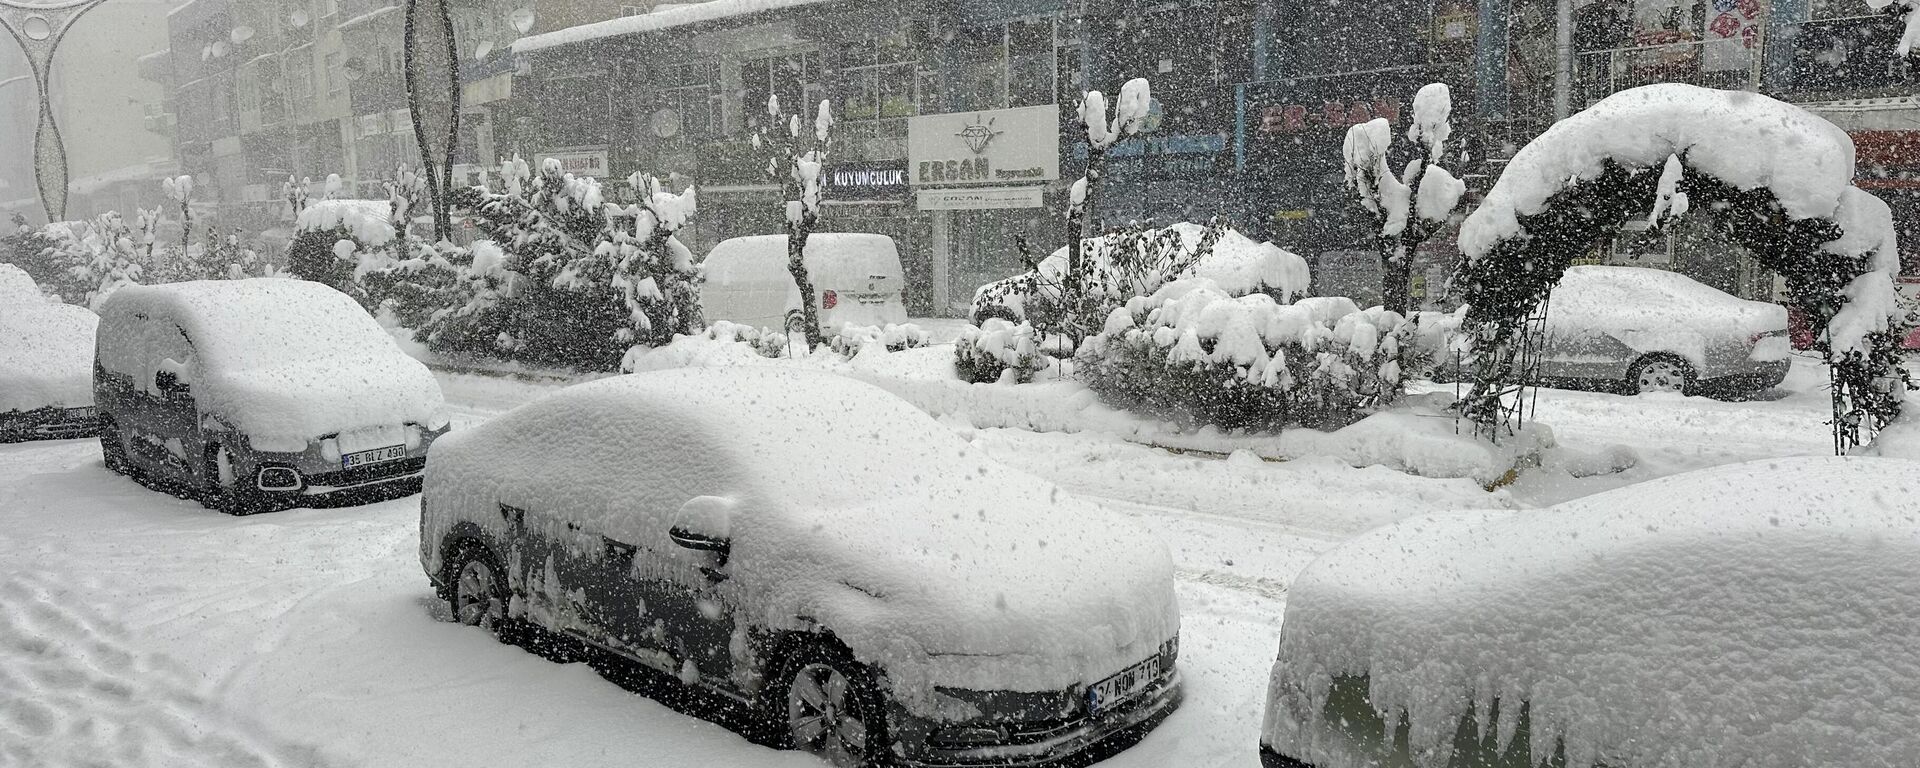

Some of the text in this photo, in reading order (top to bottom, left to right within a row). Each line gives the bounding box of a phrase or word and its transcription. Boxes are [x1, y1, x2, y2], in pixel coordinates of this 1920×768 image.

[834, 169, 904, 186] KUYUMCULUK
[918, 157, 989, 182] ERSAN
[349, 454, 361, 465] 35
[387, 446, 403, 458] 490
